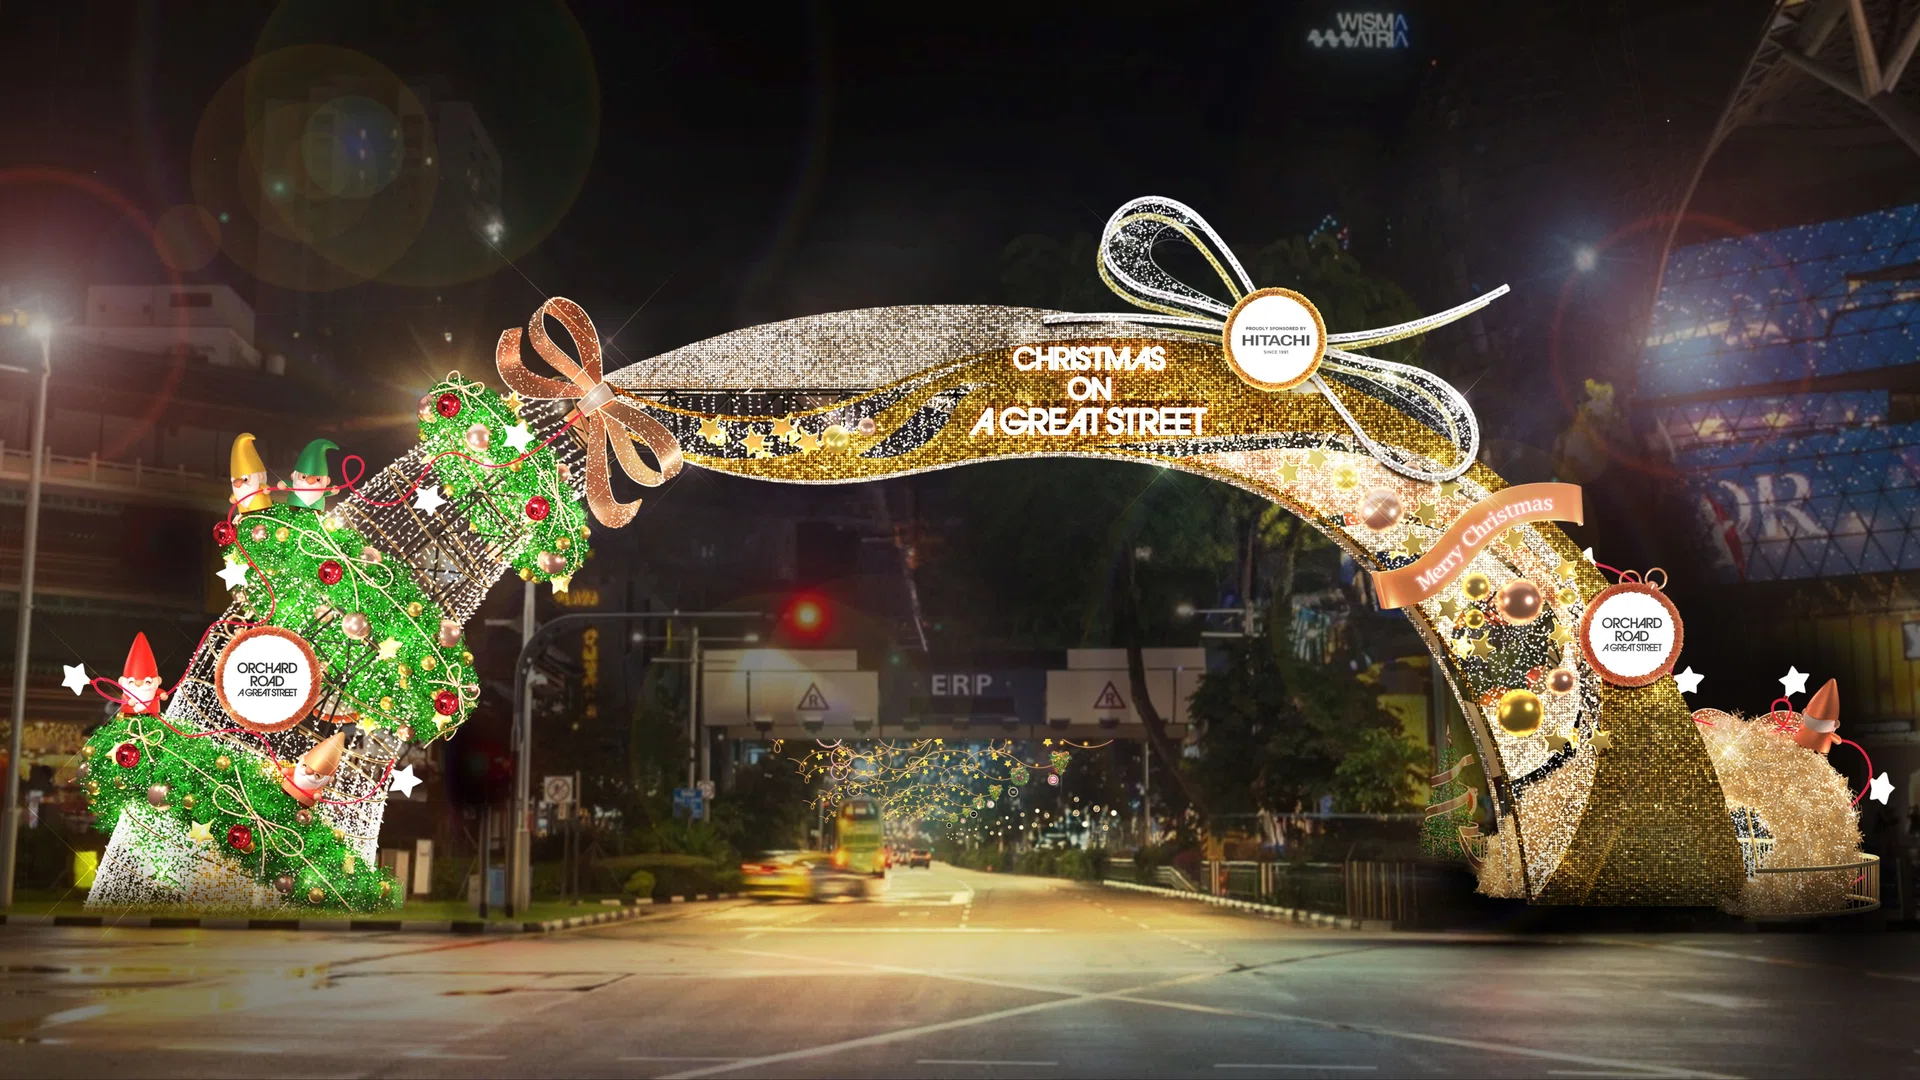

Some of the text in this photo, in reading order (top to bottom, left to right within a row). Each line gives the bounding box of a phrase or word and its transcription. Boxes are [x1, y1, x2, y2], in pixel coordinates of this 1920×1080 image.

[1337, 12, 1408, 31] WISMA
[1353, 30, 1408, 48] ATRIA
[1242, 334, 1310, 346] HITACHI
[1012, 346, 1166, 371] CHRISTMAS
[1067, 376, 1112, 401] ON
[969, 407, 1208, 436] A GREAT STREET
[1415, 498, 1553, 591] Merry Christmas
[1602, 617, 1662, 628] ORCHARD
[1615, 630, 1649, 642] ROAD
[1602, 643, 1662, 652] A GREAT STREET
[237, 662, 298, 674] ORCHARD
[250, 675, 285, 687] ROAD
[931, 673, 993, 696] ERP
[237, 688, 298, 697] A GREAT STREET
